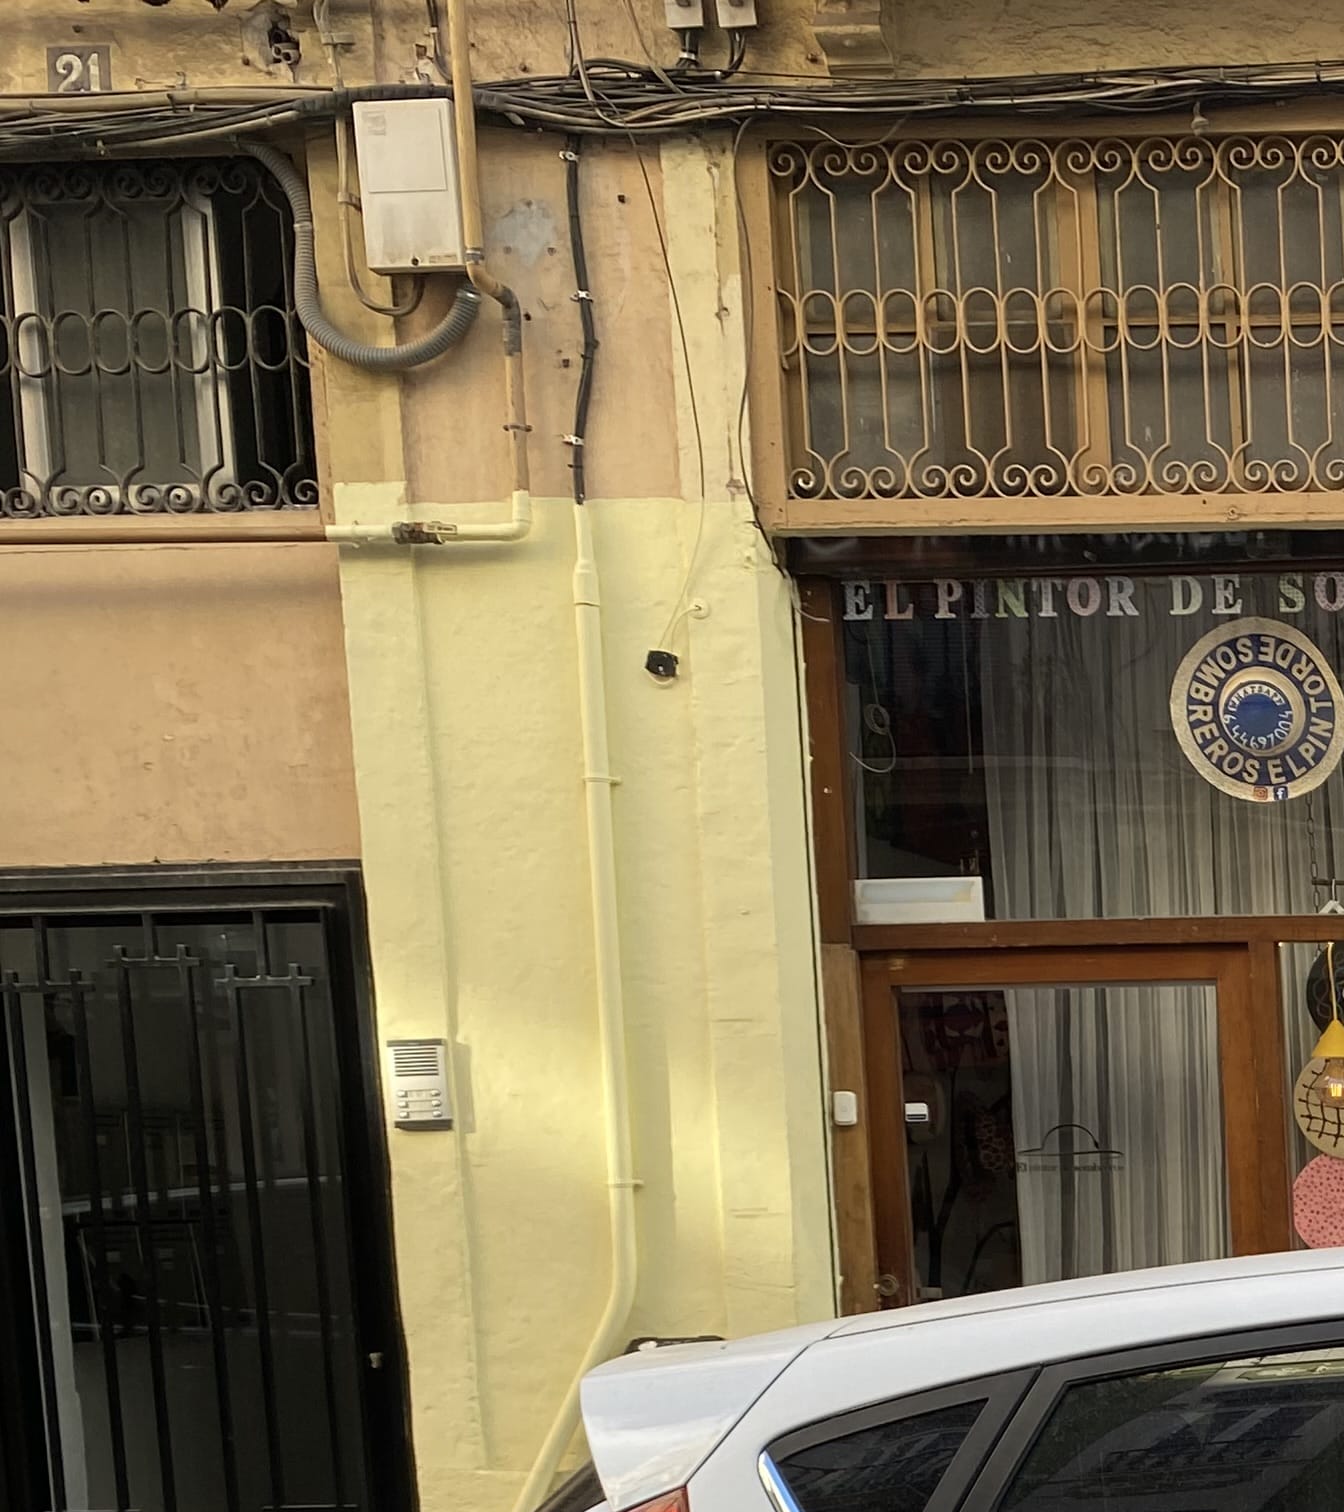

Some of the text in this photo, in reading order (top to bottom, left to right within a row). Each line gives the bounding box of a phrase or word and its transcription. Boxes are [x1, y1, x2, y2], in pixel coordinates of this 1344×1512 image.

[55, 53, 101, 92] 21
[842, 578, 915, 621] EL
[933, 575, 1140, 620] PINTOR
[1169, 572, 1243, 617] DE
[1187, 636, 1261, 785] SOMBREROS
